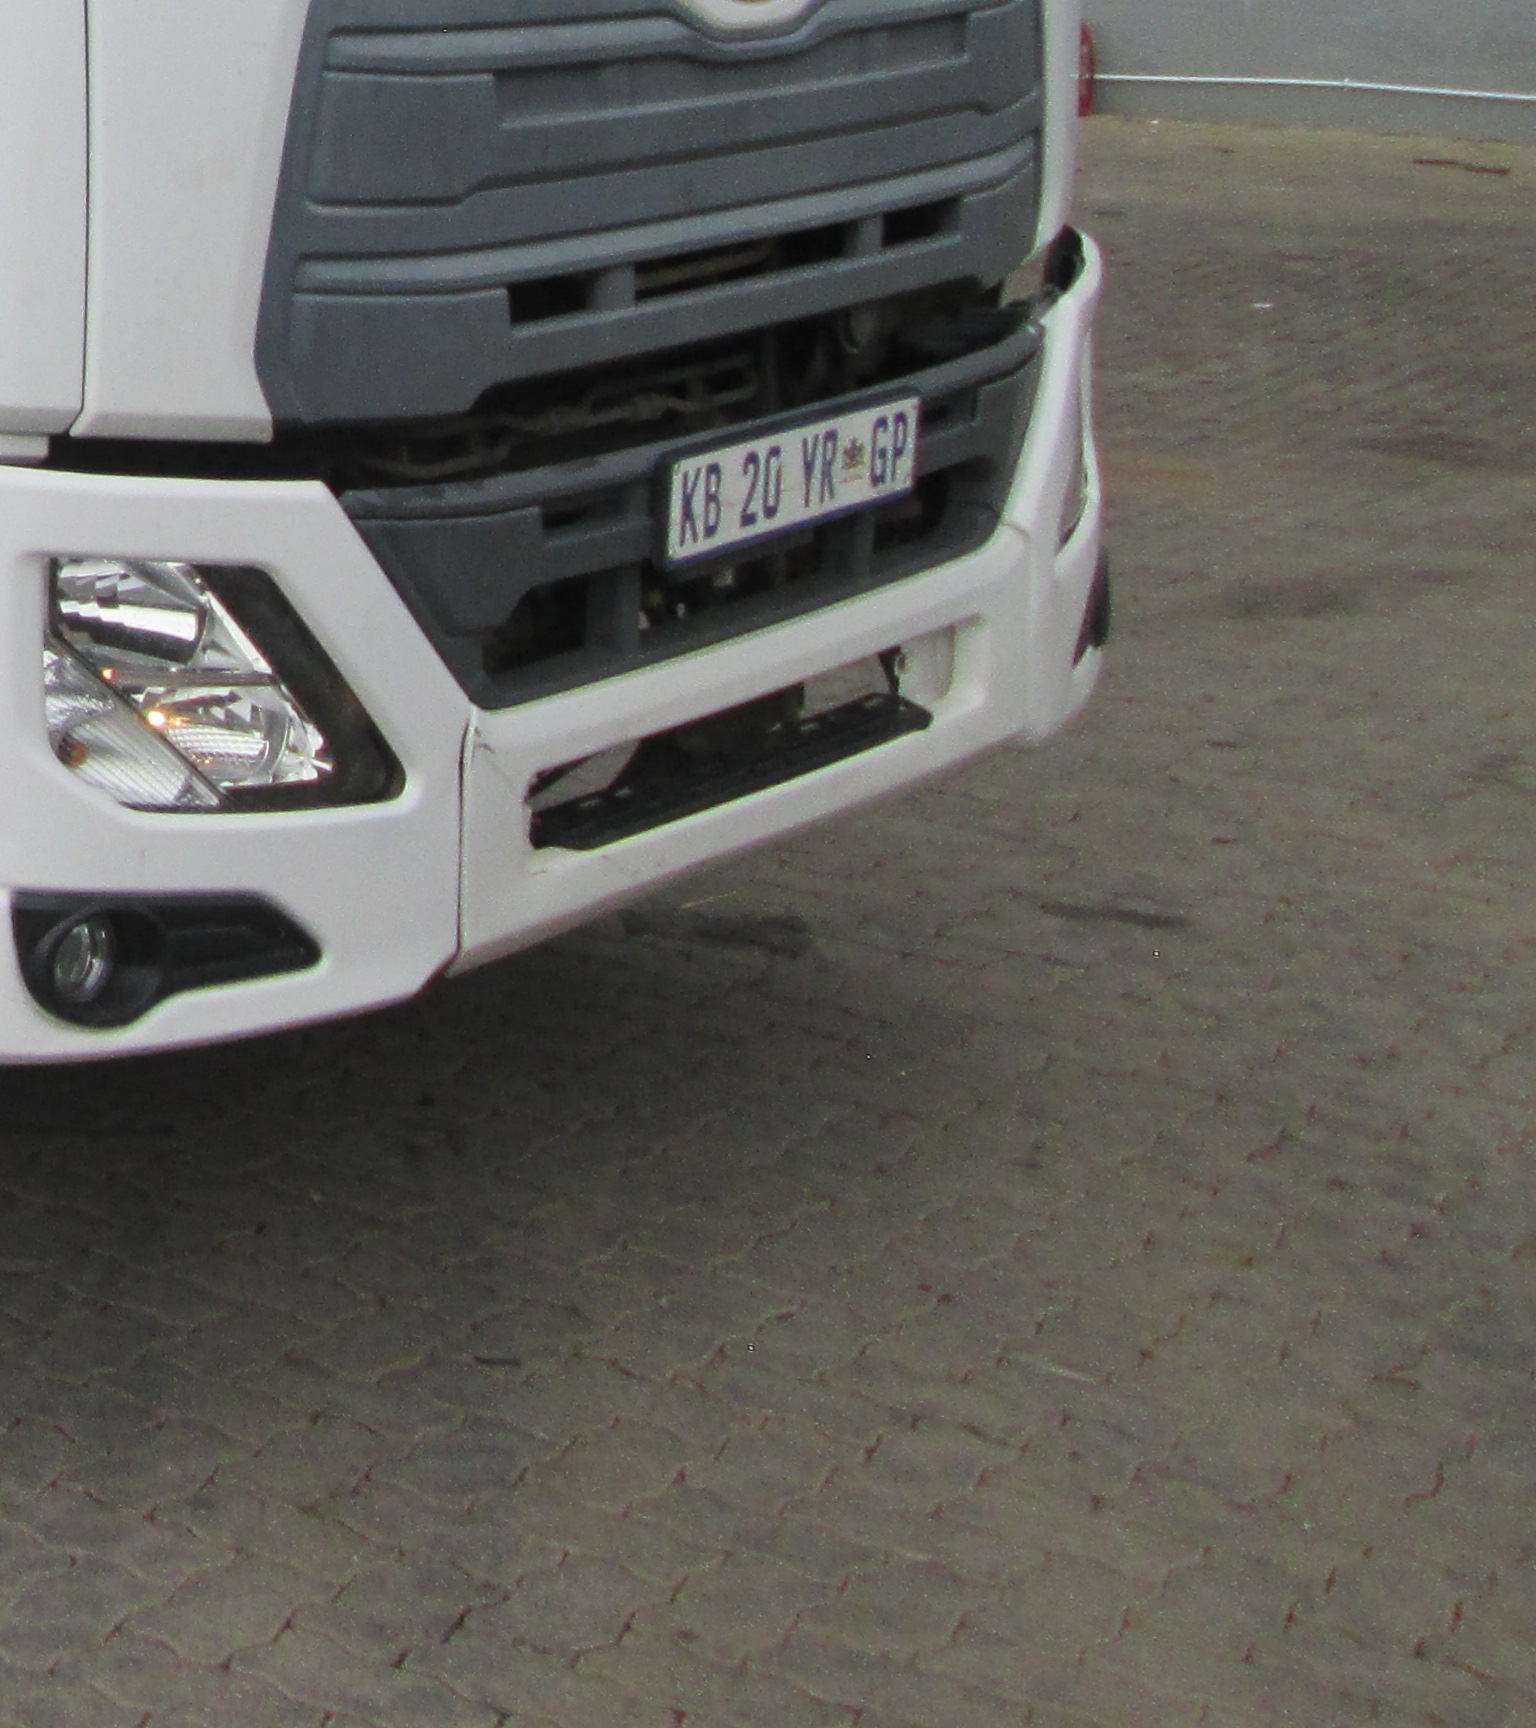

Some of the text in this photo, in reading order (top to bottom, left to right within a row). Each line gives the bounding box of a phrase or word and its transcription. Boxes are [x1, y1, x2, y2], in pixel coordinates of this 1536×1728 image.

[679, 411, 908, 547] KB 20 YR GP
